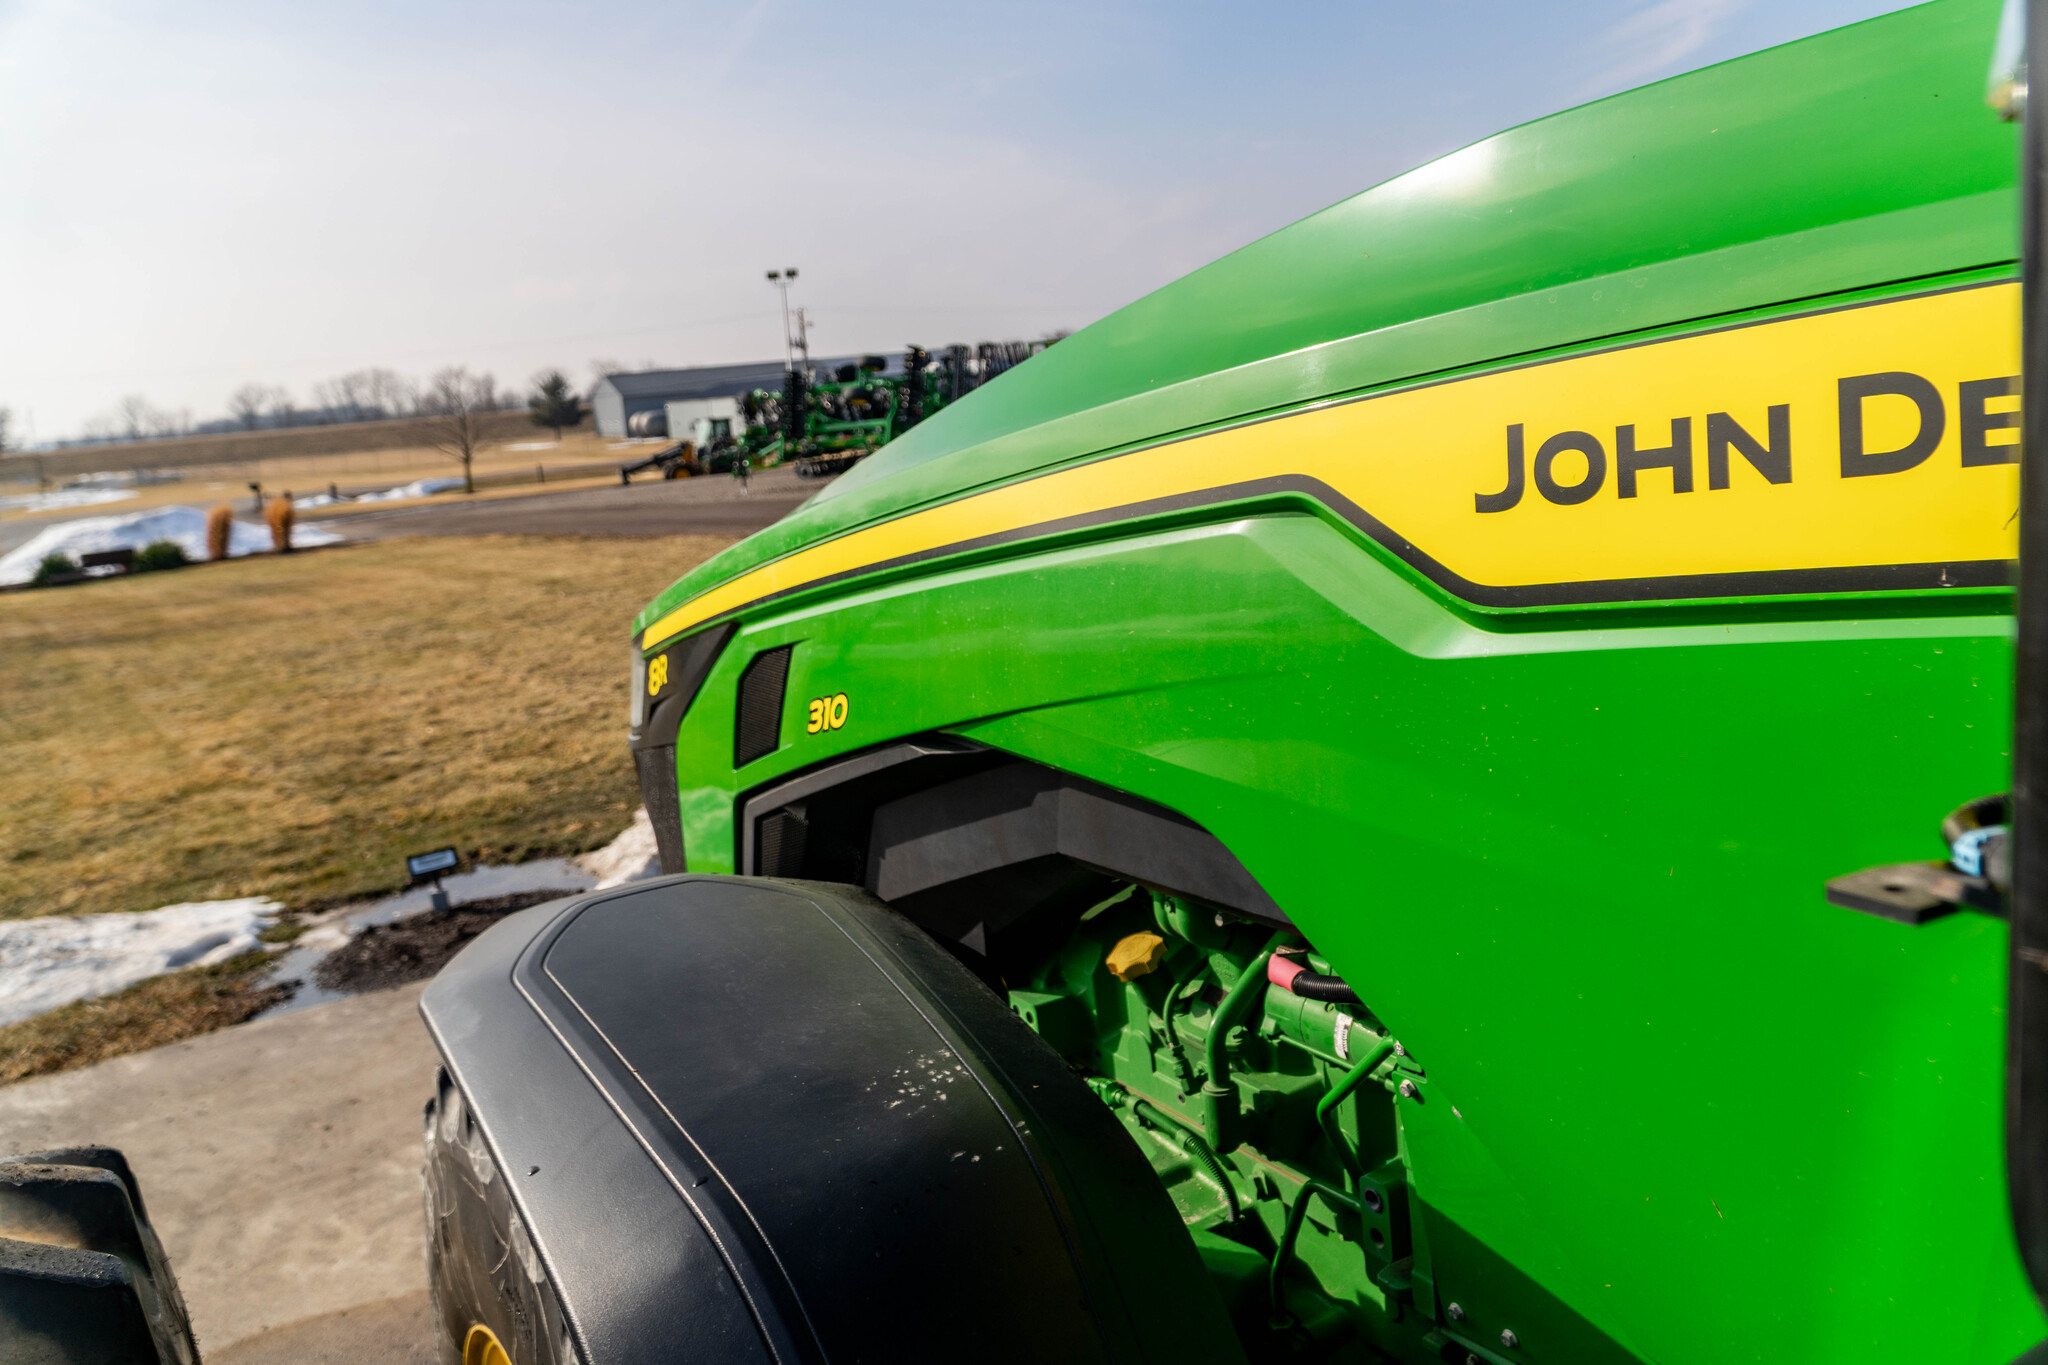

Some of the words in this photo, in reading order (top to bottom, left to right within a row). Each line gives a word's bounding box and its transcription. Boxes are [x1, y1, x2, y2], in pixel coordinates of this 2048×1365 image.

[1475, 404, 1793, 514] JOHN
[648, 654, 668, 697] 8R
[807, 693, 849, 734] 310
